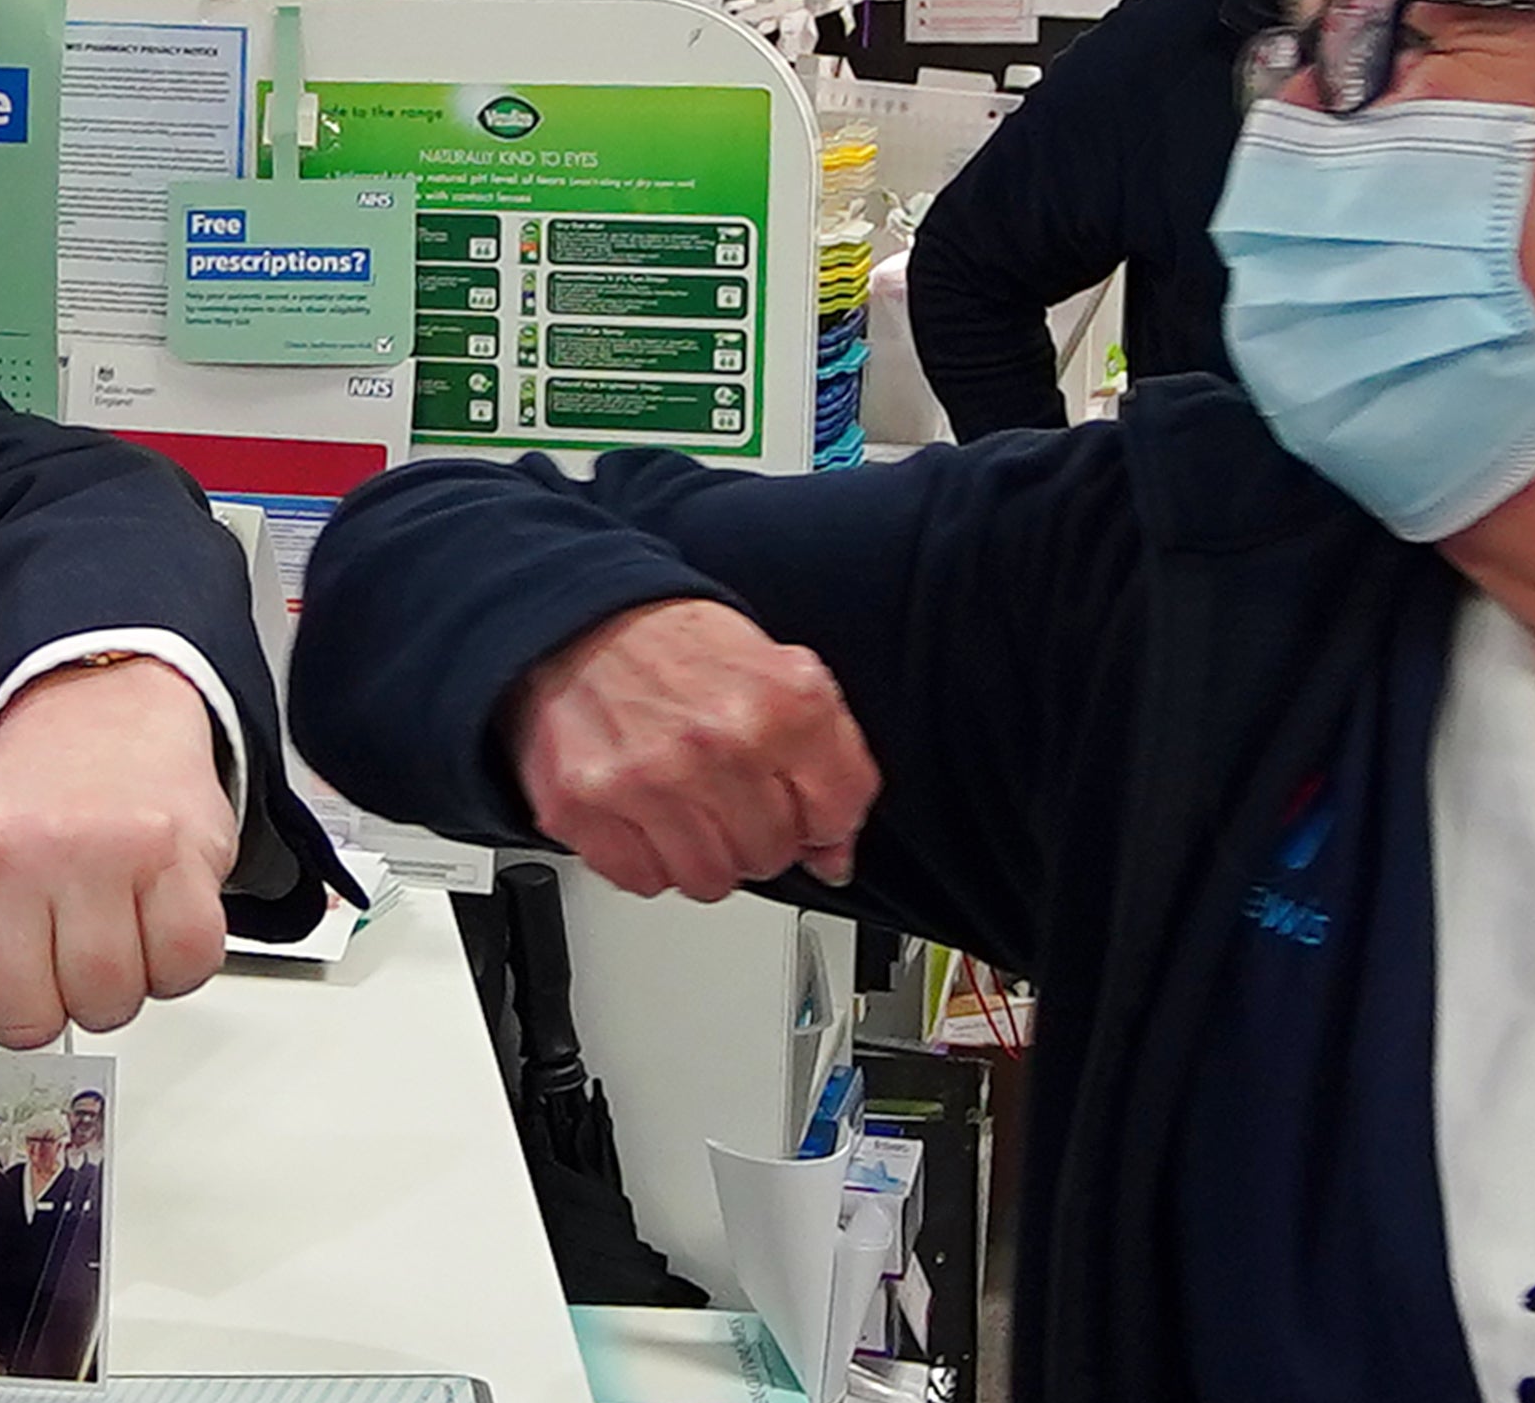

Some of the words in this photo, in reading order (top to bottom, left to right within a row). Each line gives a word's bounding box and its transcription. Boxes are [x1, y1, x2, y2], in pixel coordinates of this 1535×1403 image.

[352, 107, 369, 118] to
[372, 106, 394, 118] the
[401, 108, 443, 122] range
[419, 149, 495, 165] NATURALLY
[499, 151, 534, 166] KIND
[540, 152, 560, 166] TO
[564, 152, 599, 167] EYES
[358, 193, 392, 207] NHS
[191, 214, 242, 234] Free
[191, 251, 366, 276] prescriptions?
[350, 378, 393, 396] NHS
